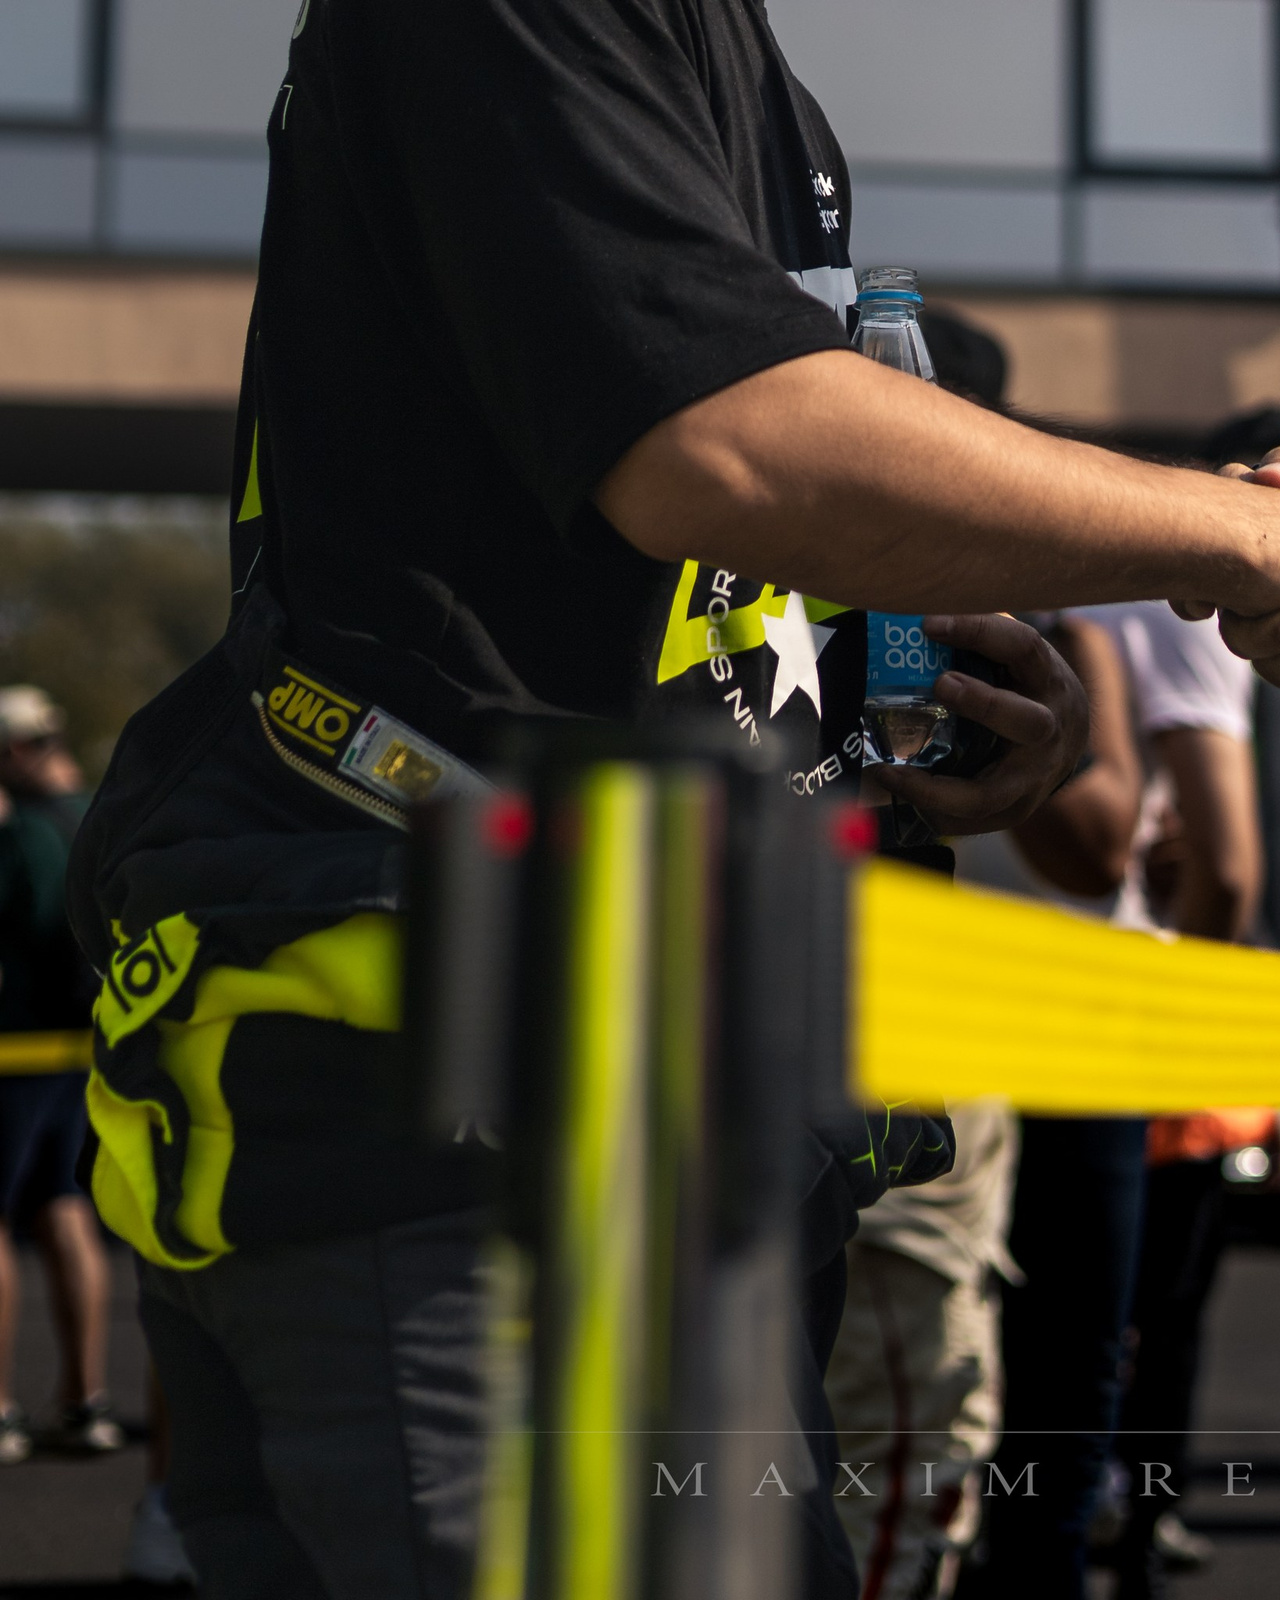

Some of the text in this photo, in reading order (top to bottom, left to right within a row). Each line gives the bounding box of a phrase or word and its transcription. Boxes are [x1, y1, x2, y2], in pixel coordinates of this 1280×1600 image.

[706, 568, 737, 683] SPOR
[884, 647, 950, 675] aqua
[268, 681, 350, 742] OMP
